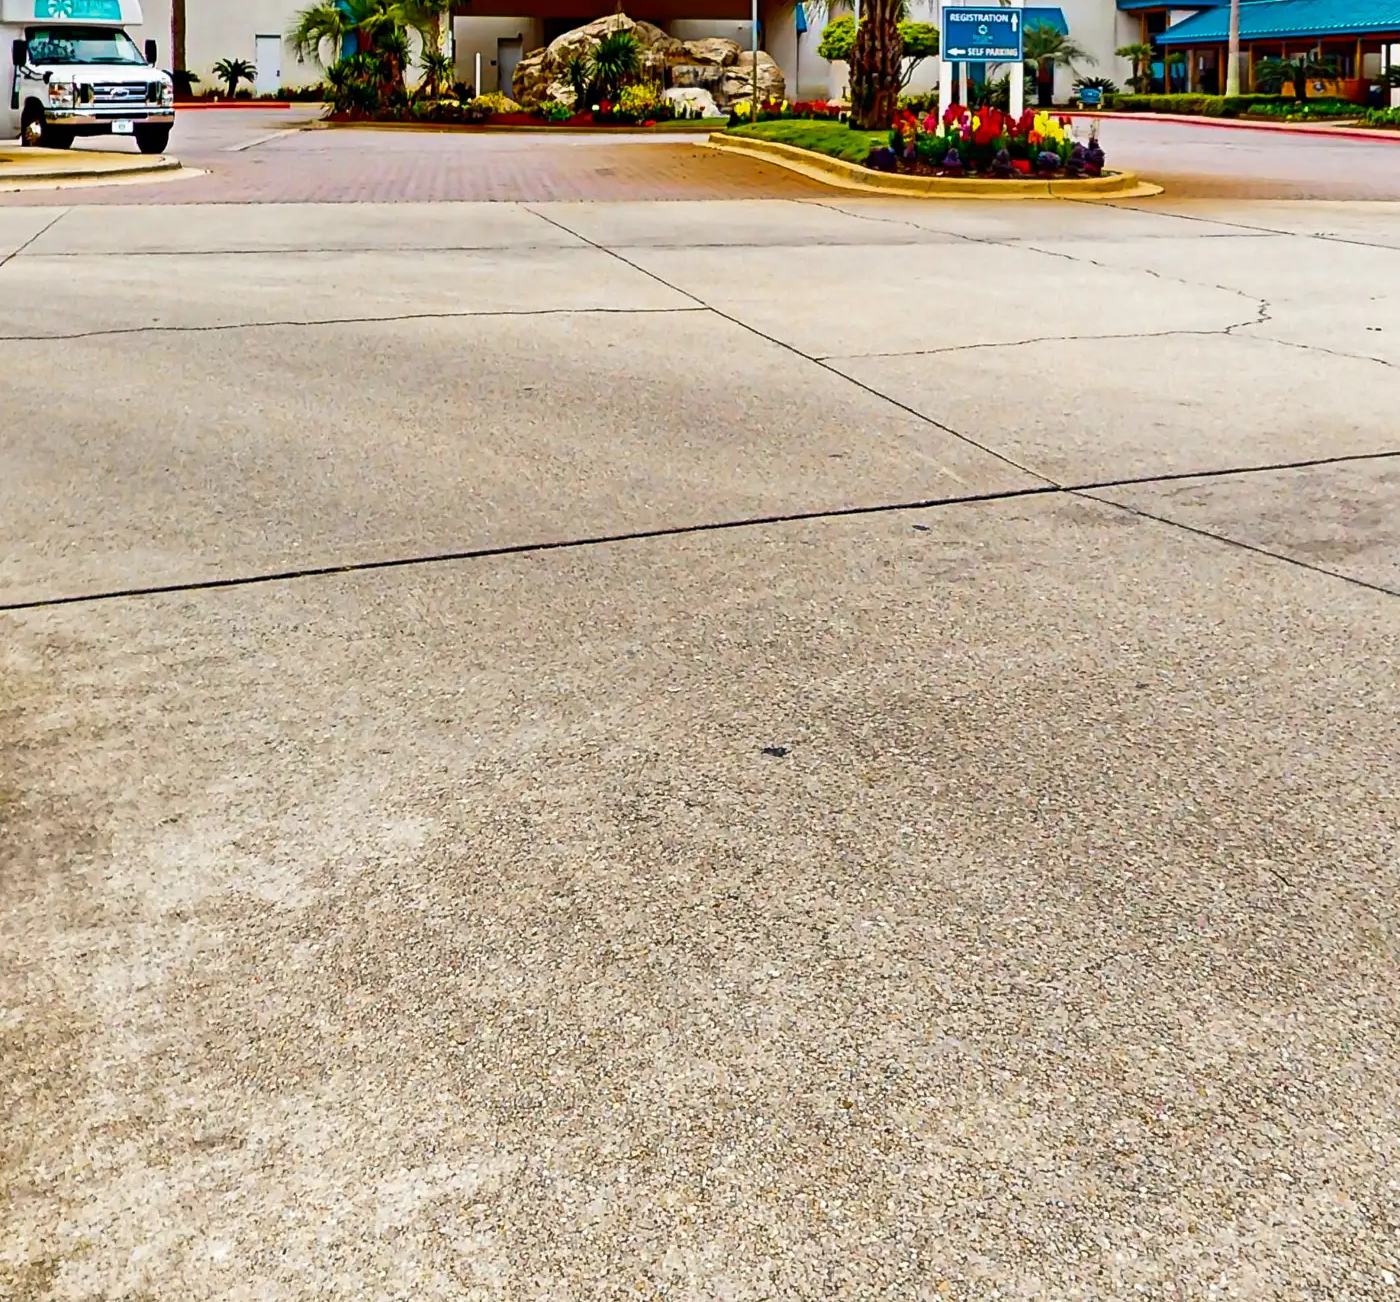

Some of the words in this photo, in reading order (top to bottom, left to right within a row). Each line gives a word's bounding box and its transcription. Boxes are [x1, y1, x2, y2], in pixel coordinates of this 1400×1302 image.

[950, 13, 1008, 22] REGISTRATION
[967, 48, 984, 56] SELF
[986, 48, 1017, 57] PARKING
